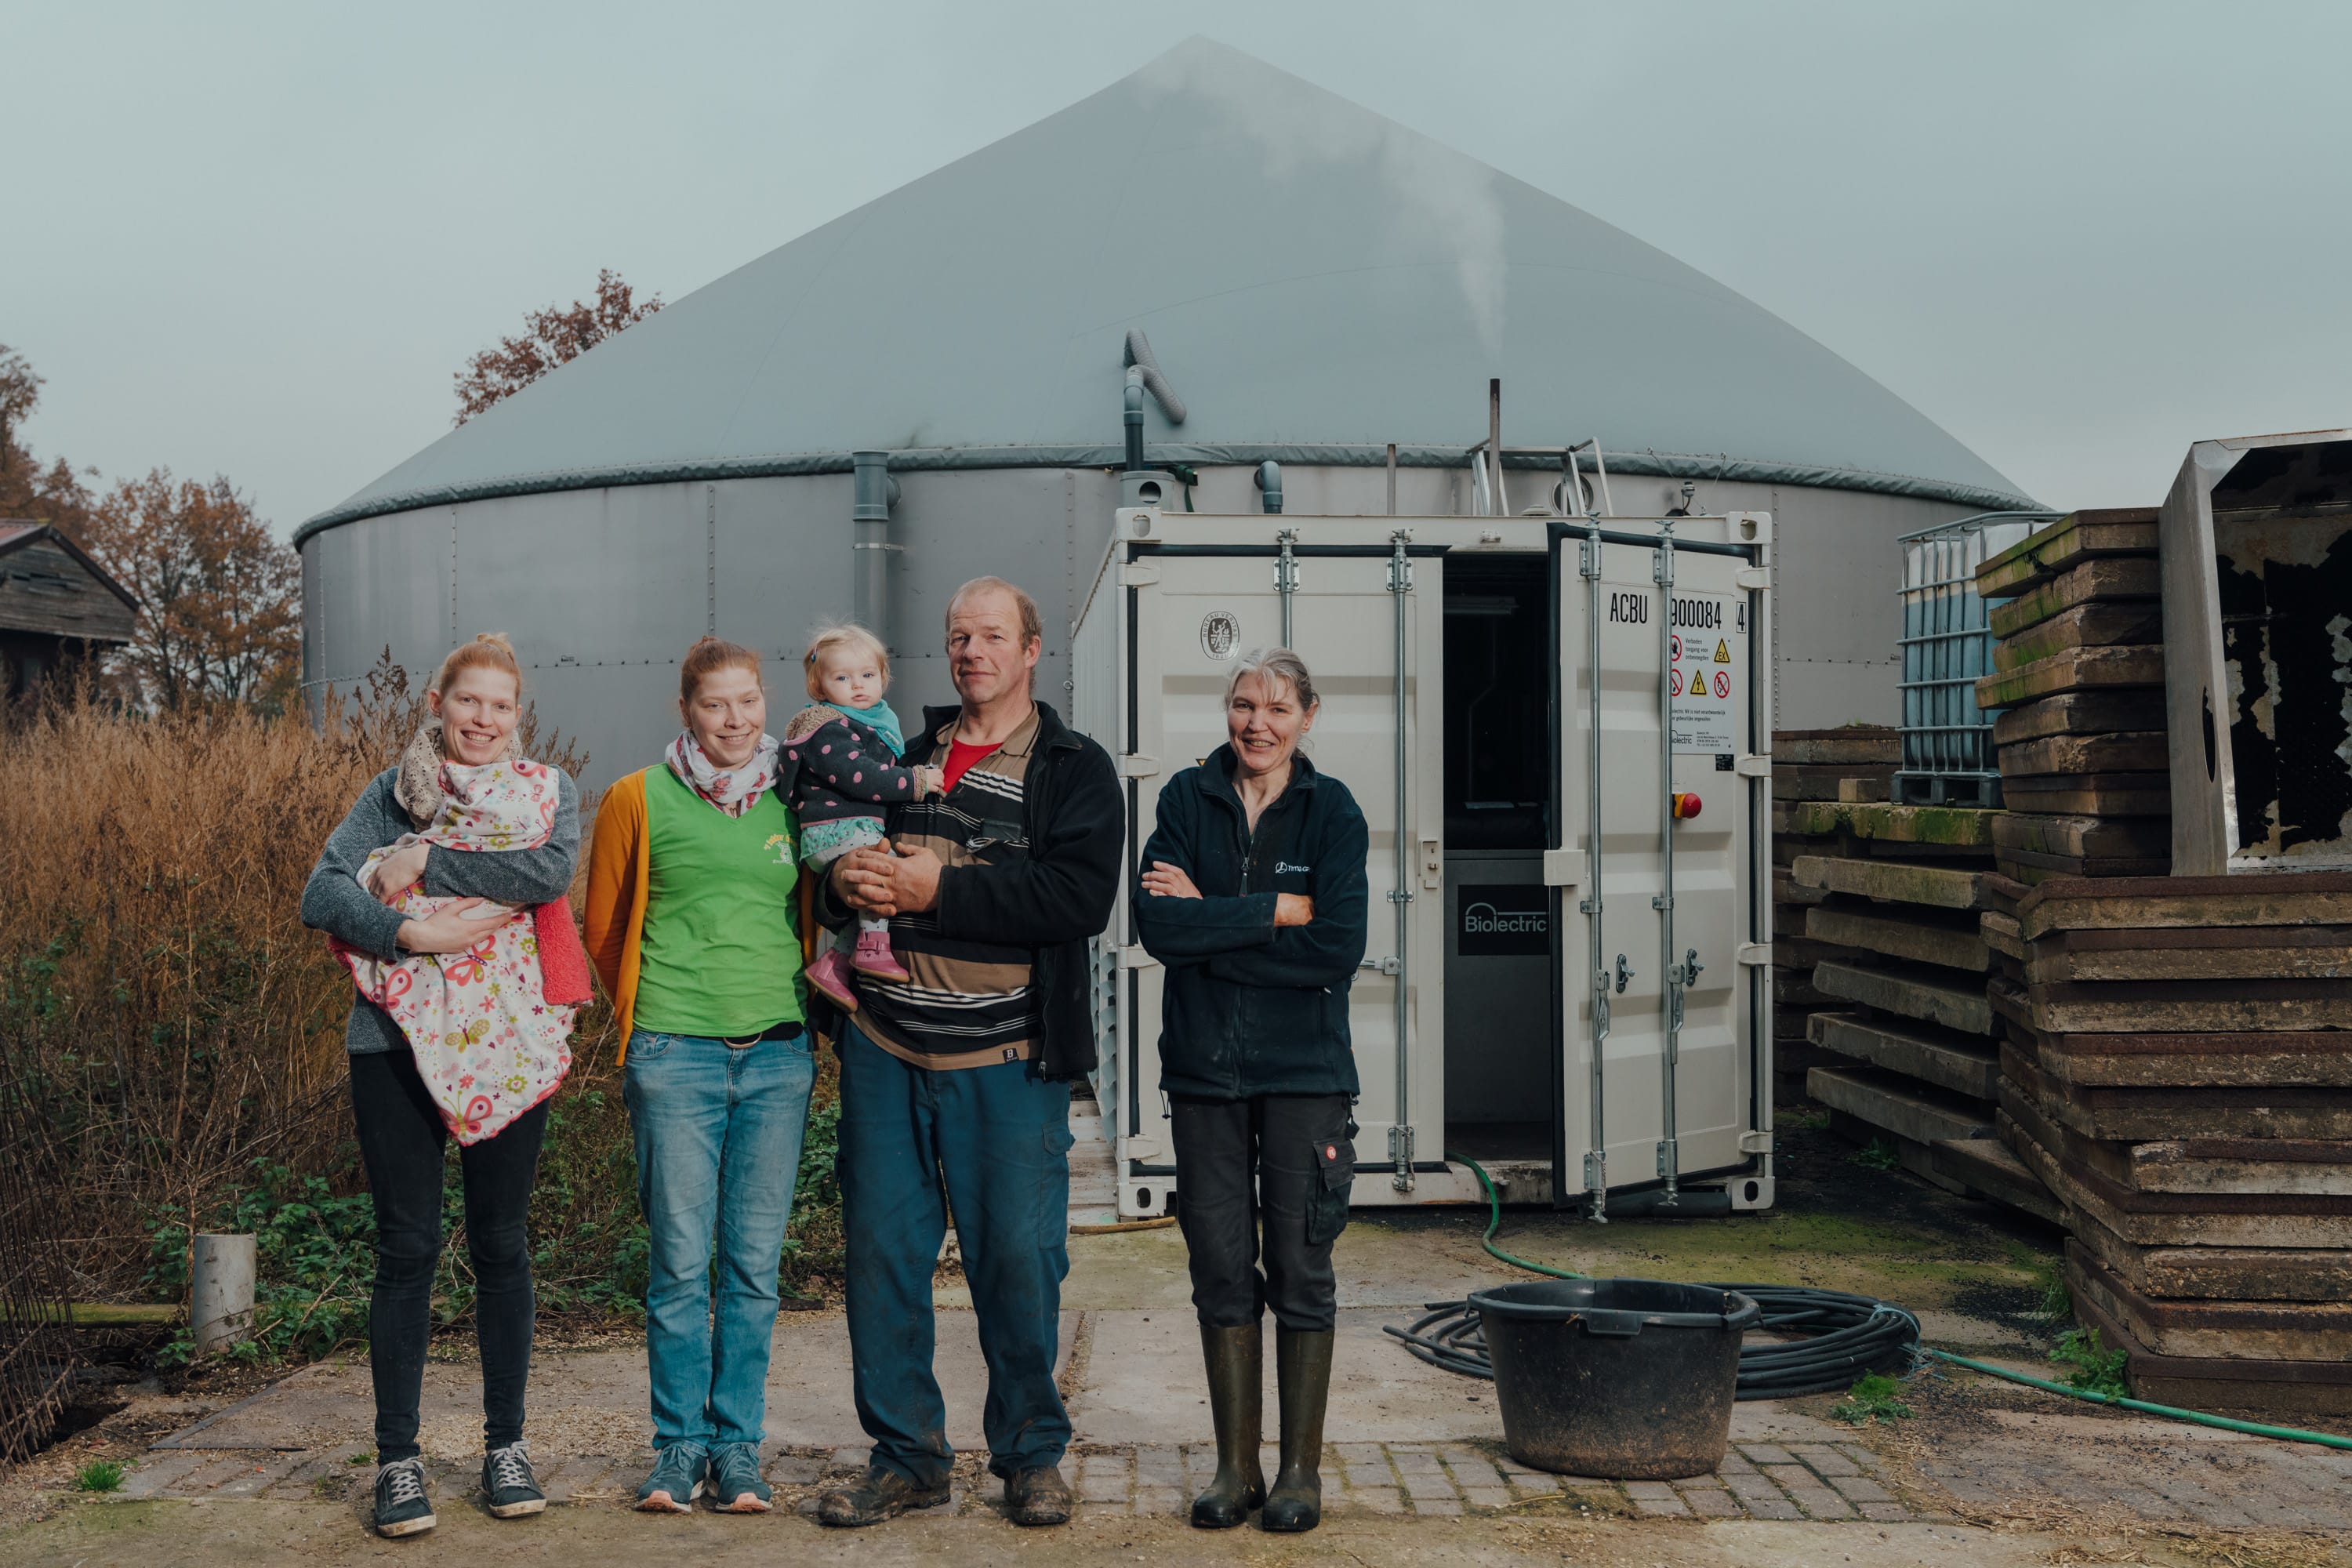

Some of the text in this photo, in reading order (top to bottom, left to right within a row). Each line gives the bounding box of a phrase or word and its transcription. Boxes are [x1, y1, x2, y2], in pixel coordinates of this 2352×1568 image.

[1610, 593, 1745, 631] ACBU 900084 4
[1465, 915, 1547, 933] Biolectric
